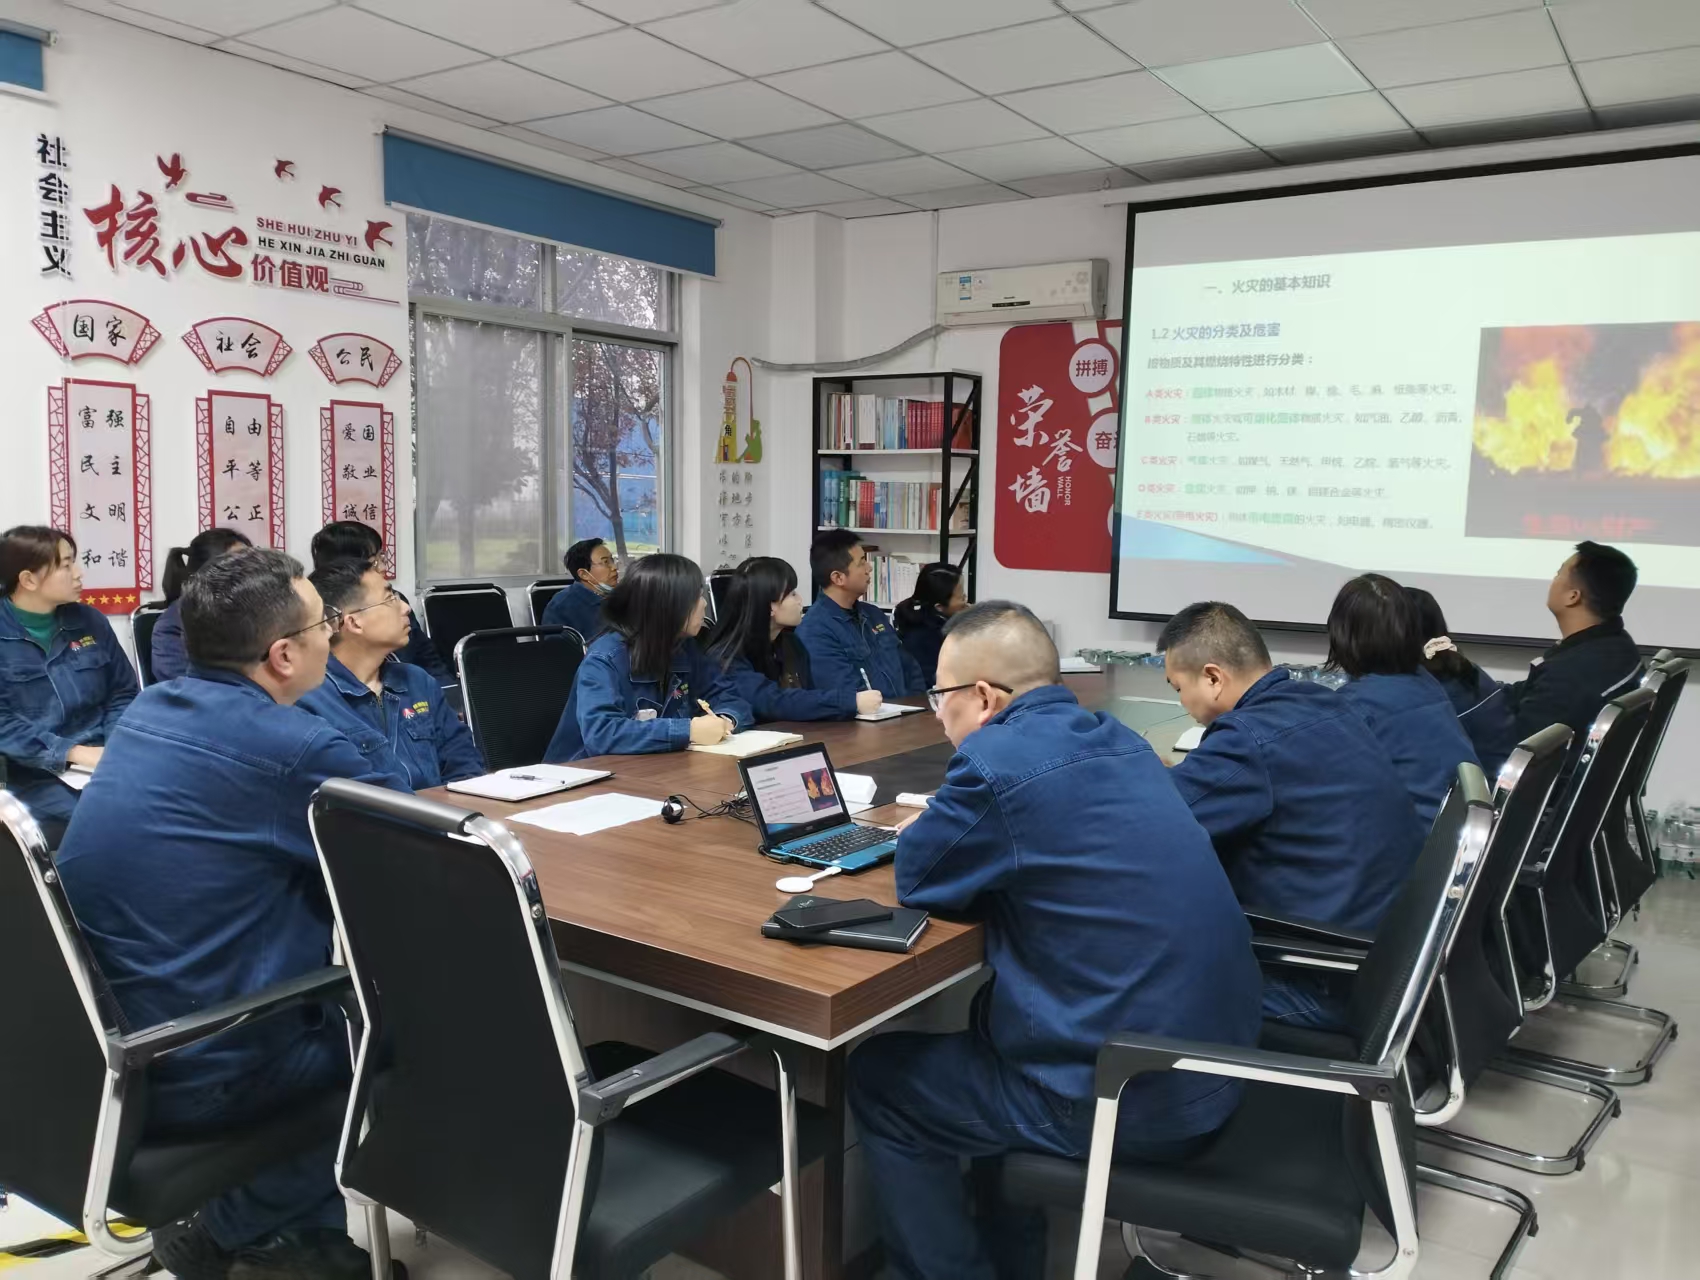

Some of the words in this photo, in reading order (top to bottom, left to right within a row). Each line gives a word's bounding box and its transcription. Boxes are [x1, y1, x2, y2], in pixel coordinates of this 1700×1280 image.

[37, 133, 72, 276] 社会主义
[83, 184, 249, 278] 核心
[257, 217, 283, 231] SHE
[288, 224, 311, 236] HUI
[315, 229, 341, 243] ZHU
[345, 234, 358, 246] YI
[258, 236, 276, 249] HE
[280, 240, 302, 253] XIN
[306, 246, 326, 258] JIA
[329, 250, 349, 262] ZHI
[353, 254, 385, 268] GUAN
[251, 253, 329, 293] 价值观
[73, 314, 127, 347] 国家
[216, 330, 262, 359] 社会
[336, 346, 374, 372] 公民
[1075, 358, 1109, 377] 拼搏
[78, 405, 125, 429] 富强
[225, 416, 262, 436] 自由
[342, 423, 375, 442] 爱国
[1008, 384, 1084, 513] 荣誉墙
[80, 454, 122, 476] 民主
[222, 459, 263, 481] 平等
[342, 464, 378, 480] 敬业
[80, 502, 126, 522] 文明
[224, 504, 264, 521] 公正
[342, 504, 378, 521] 诚信
[82, 548, 129, 569] 和谐
